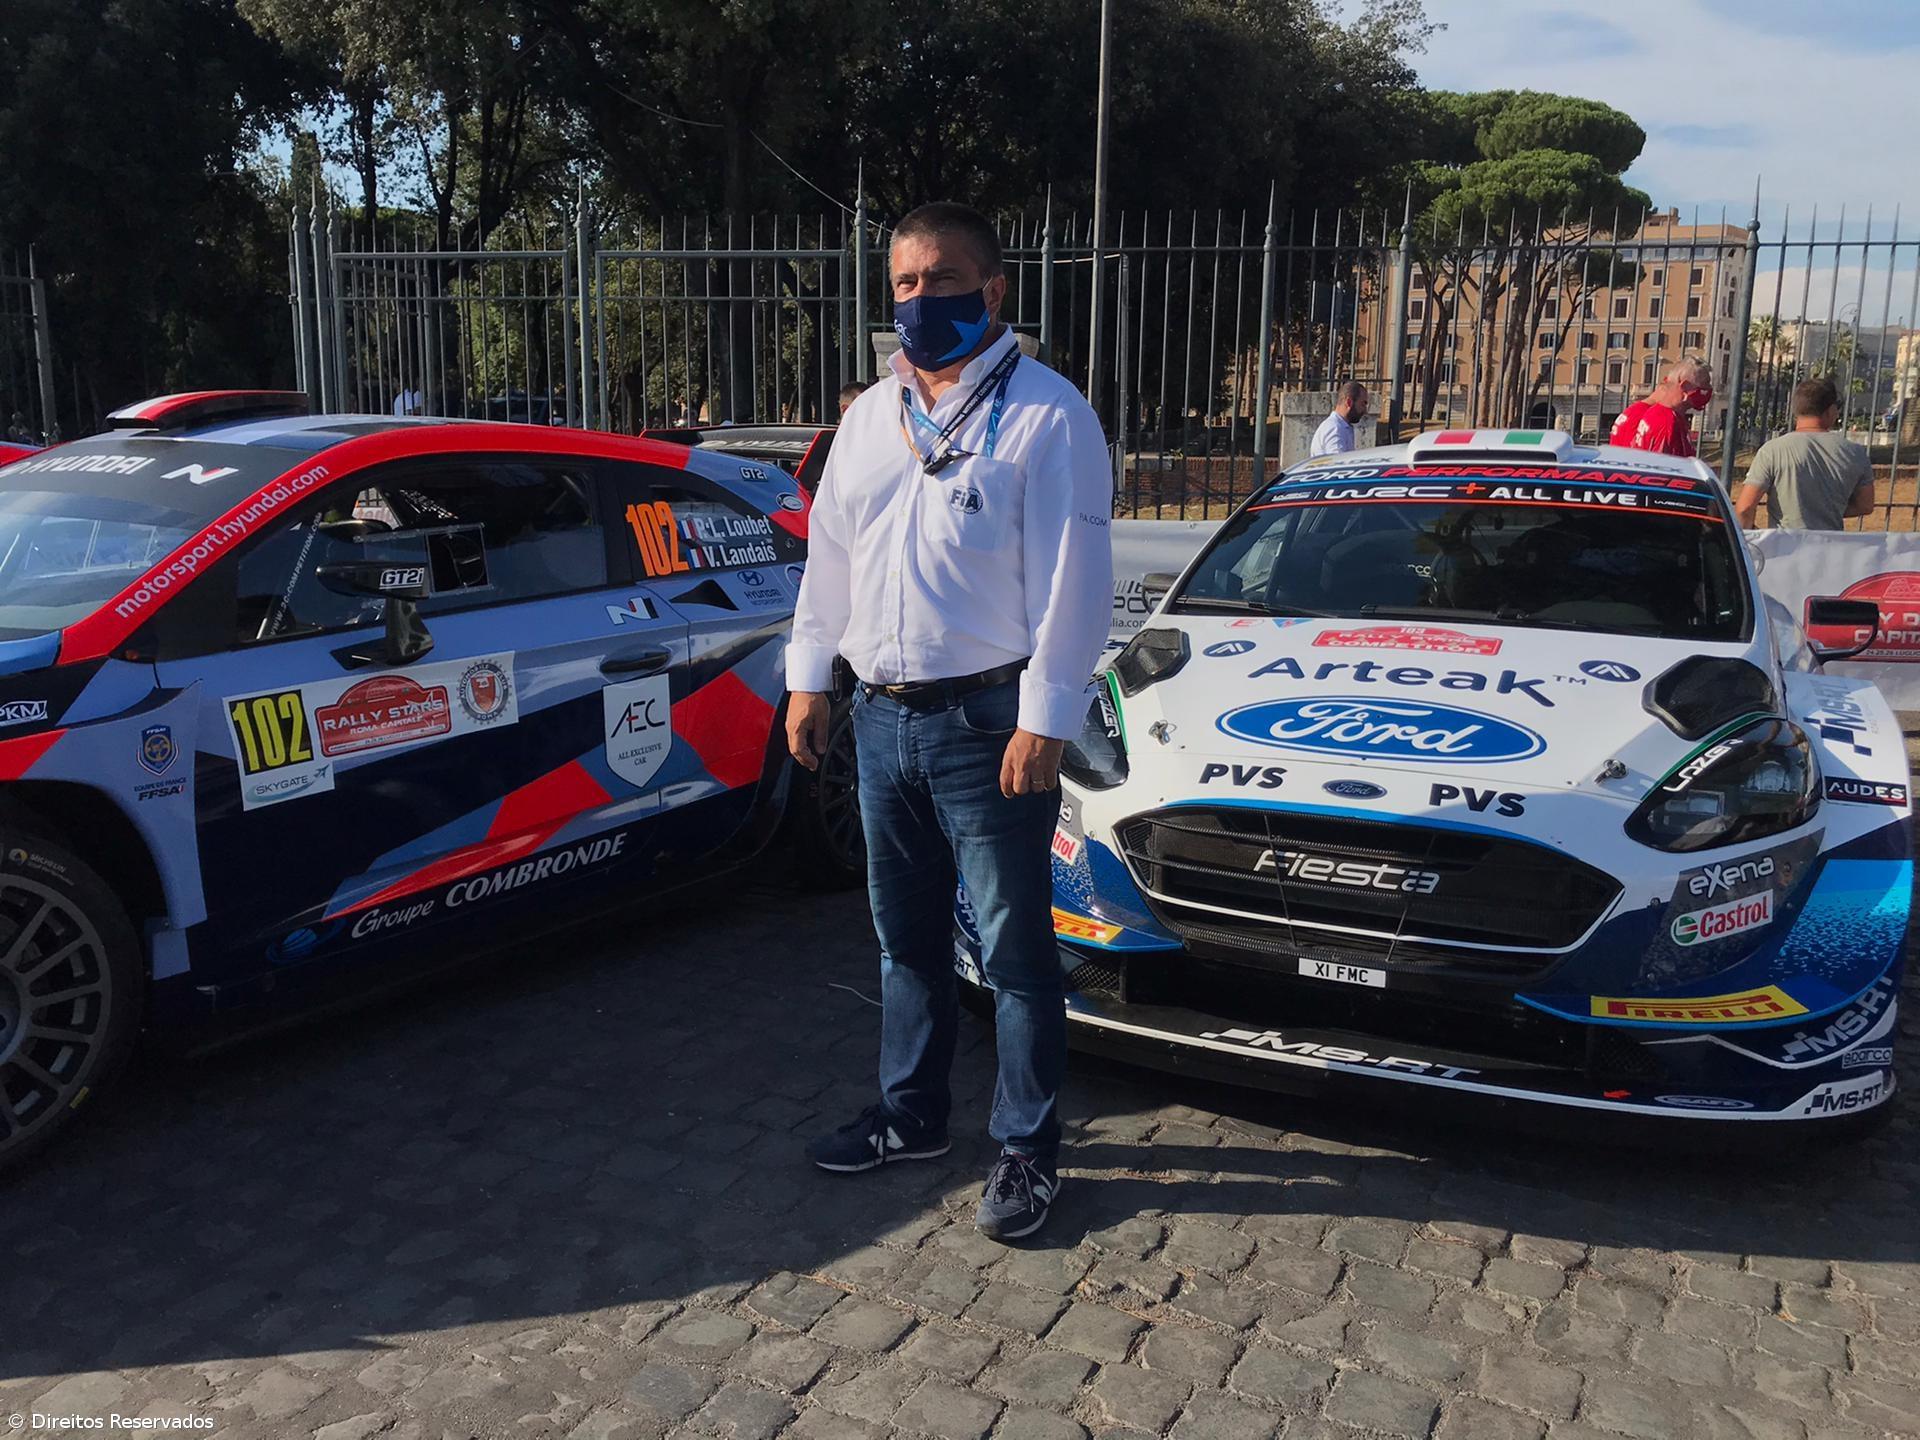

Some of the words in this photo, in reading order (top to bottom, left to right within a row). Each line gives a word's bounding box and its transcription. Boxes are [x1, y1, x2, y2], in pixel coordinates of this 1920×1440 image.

[20, 455, 156, 475] HYUNDAI
[1278, 468, 1380, 486] FORD
[1381, 465, 1697, 491] PERFORMANCE
[1488, 486, 1553, 503] ALL
[1563, 490, 1638, 507] LIVE
[625, 500, 691, 578] 102
[723, 514, 774, 538] Loubet
[115, 463, 329, 619] motorsport.hyundai.com
[701, 544, 721, 569] V.
[719, 540, 778, 567] Landais
[381, 567, 425, 586] GT2i
[1400, 625, 1426, 635] 103
[1327, 640, 1482, 654] COMPETITOR
[1247, 656, 1556, 708] Arteak
[322, 709, 382, 732] RALLY
[388, 698, 446, 719] STARS
[610, 698, 666, 738] AEC
[1269, 700, 1484, 754] Ford
[231, 691, 313, 773] 102
[348, 724, 379, 736] ROMA
[255, 775, 309, 795] SKYGATE
[1198, 762, 1289, 789] PVS
[138, 785, 180, 802] FFSA
[1428, 782, 1528, 818] PVS
[1828, 781, 1906, 801] AUDES
[1253, 848, 1441, 894] Fiesta
[351, 899, 435, 939] Groupe
[445, 831, 628, 908] COMBRONDE
[1699, 895, 1770, 938] Castrol
[1335, 967, 1369, 984] FMC
[1607, 994, 1786, 1020] PIRELLI
[1843, 1049, 1892, 1066] sparco
